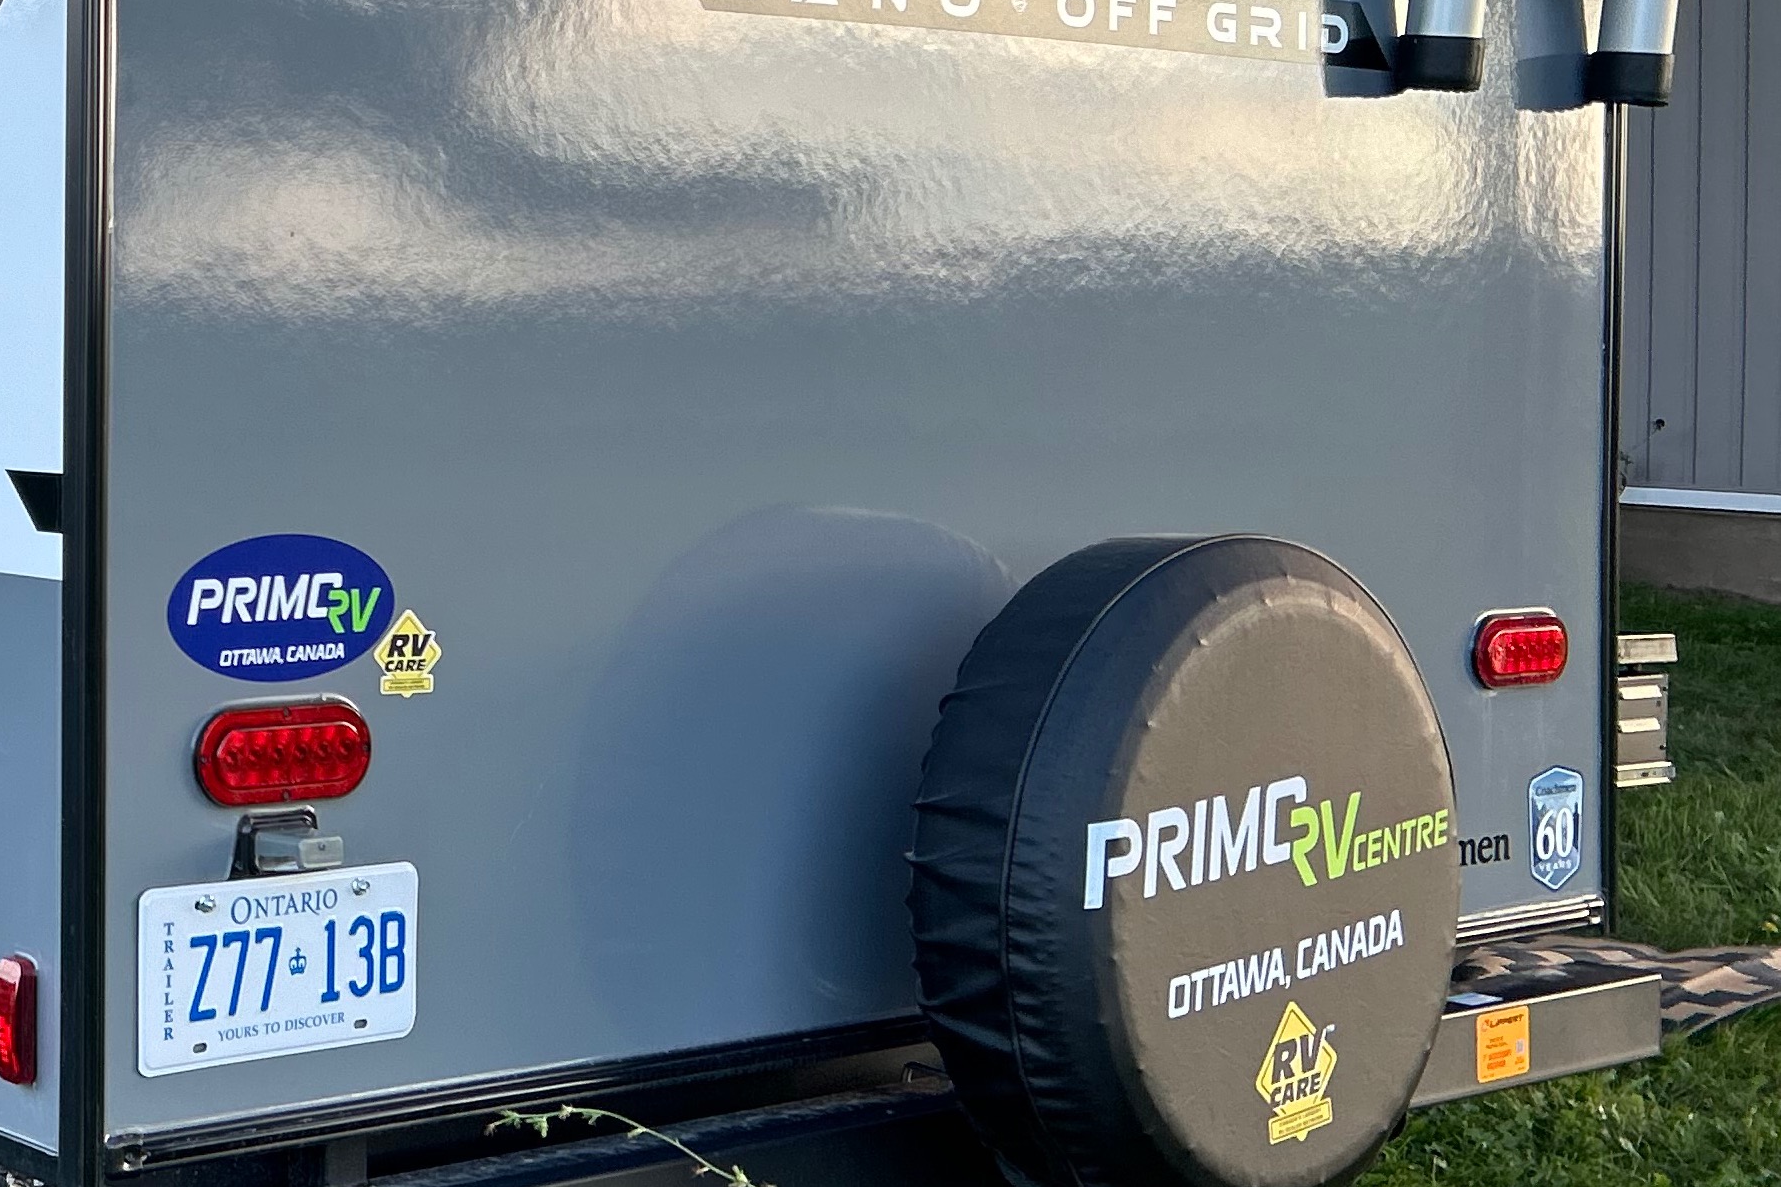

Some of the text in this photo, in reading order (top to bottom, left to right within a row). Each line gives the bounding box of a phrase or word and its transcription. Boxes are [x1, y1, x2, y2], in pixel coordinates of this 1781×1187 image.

[1206, 3, 1349, 55] GRID
[286, 643, 345, 662] CANADA
[385, 659, 426, 672] CARE
[387, 633, 431, 658] RV
[1353, 808, 1449, 872] CENTRE
[1536, 807, 1574, 860] 60
[230, 888, 338, 925] ONTARIO
[163, 922, 175, 1041] TRAILER
[1168, 909, 1404, 1019] OTTAWA, CANADA
[218, 1012, 345, 1042] YOURS TO DISCOVER
[1271, 1028, 1323, 1085] RV
[1270, 1072, 1321, 1108] CARE
